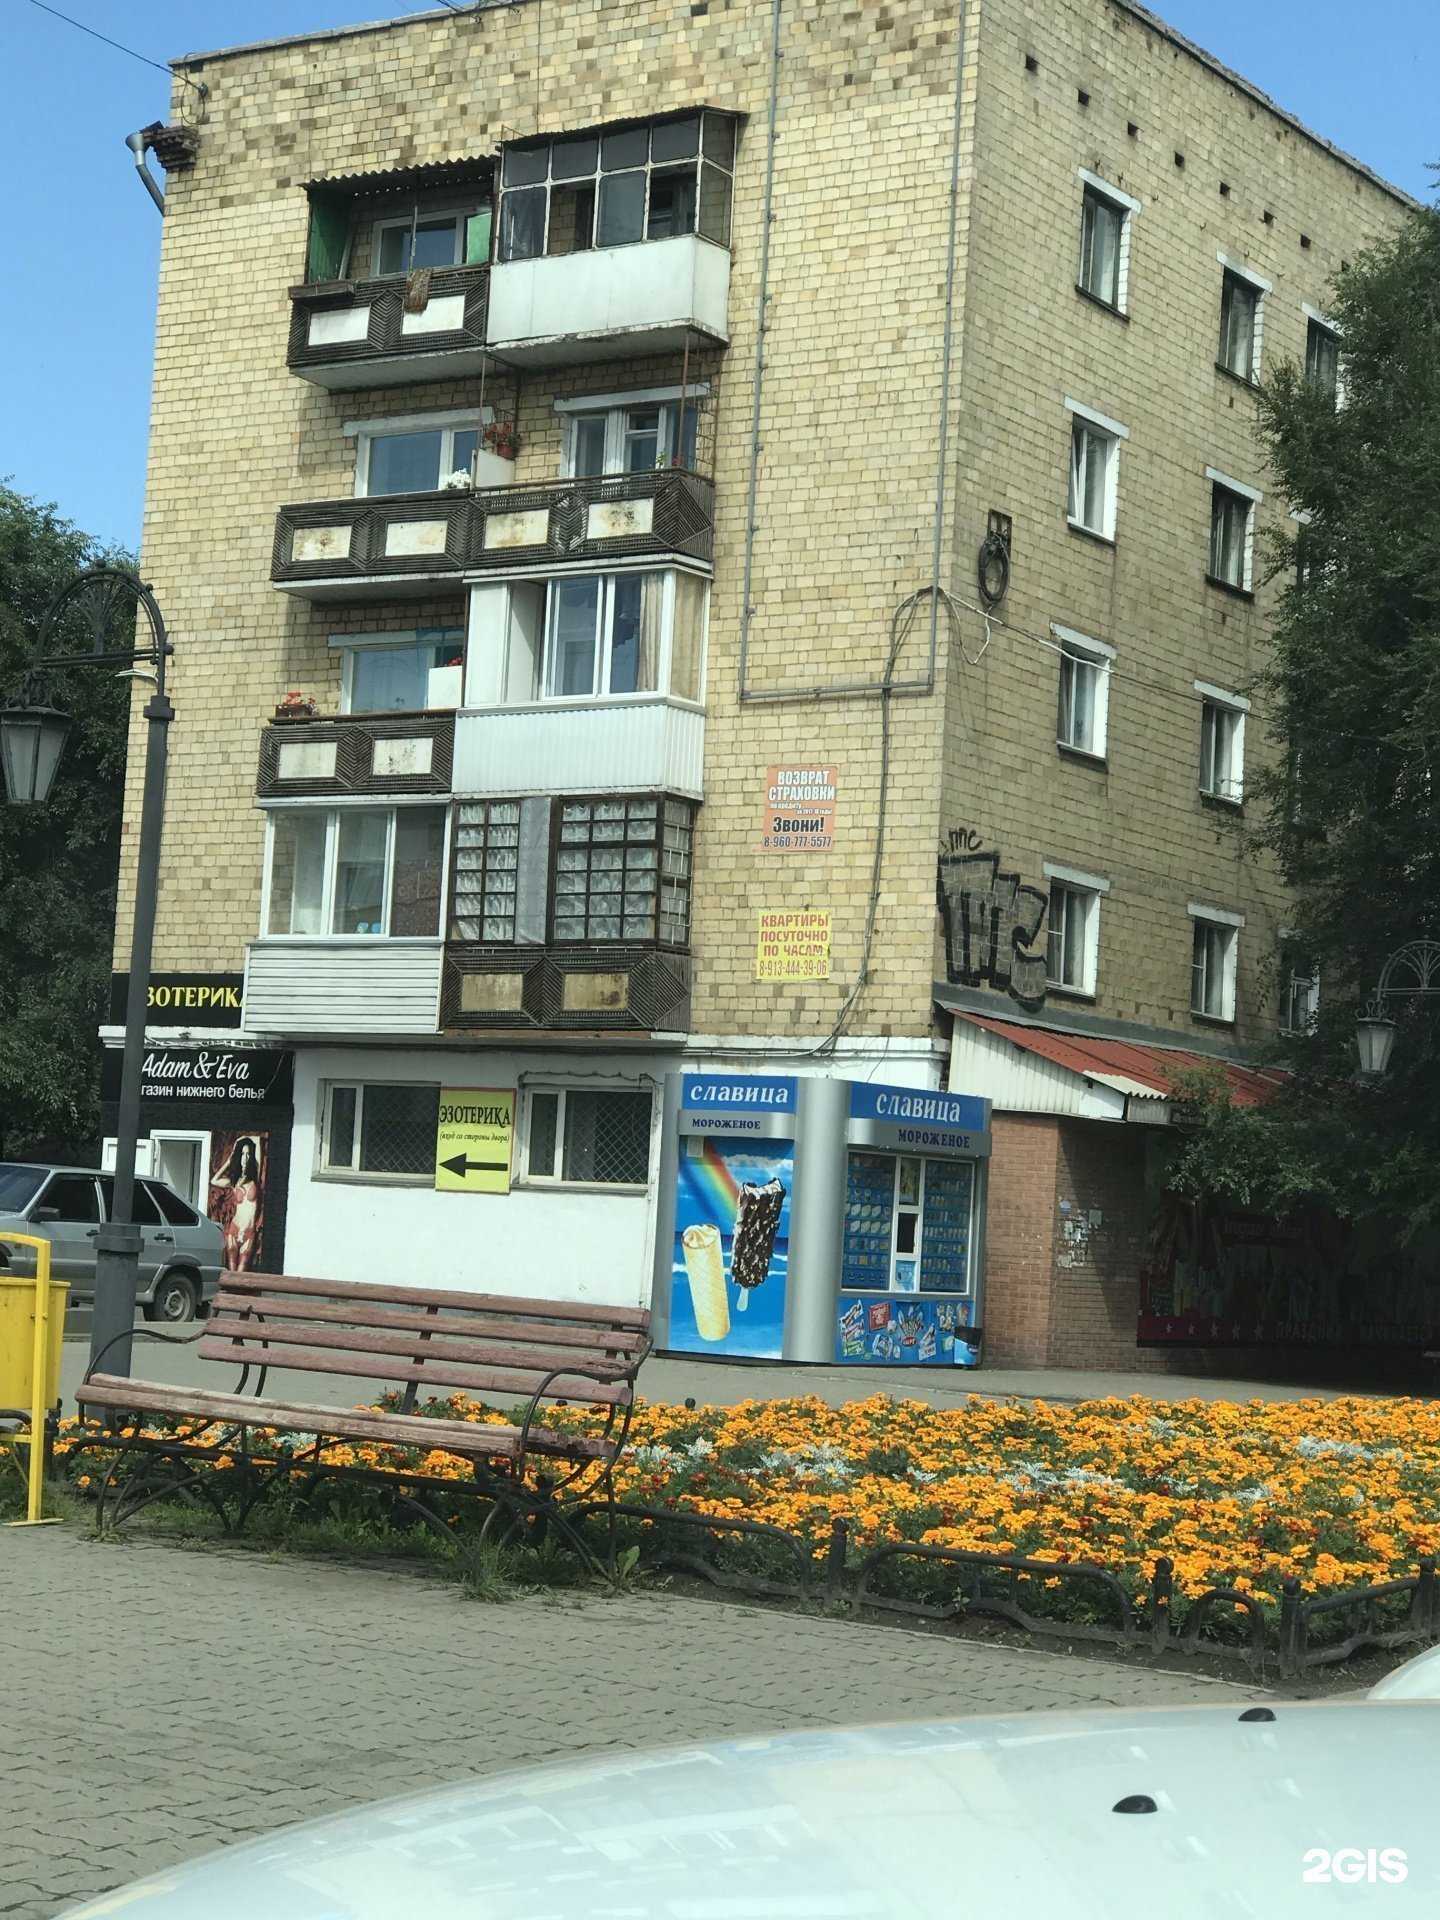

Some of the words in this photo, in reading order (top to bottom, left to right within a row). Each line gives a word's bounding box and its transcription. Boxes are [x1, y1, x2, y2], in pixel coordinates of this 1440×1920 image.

[777, 770, 829, 785] ВОЗВРАТ
[768, 785, 836, 801] СТРАХОВКИ
[773, 816, 825, 833] Звони!
[764, 836, 832, 847] 8-960-777-5577
[761, 914, 829, 927] КВАРТИРЫ
[760, 930, 828, 942] ПОСУТОЧНО
[763, 945, 779, 956] ПО
[783, 945, 823, 956] ЧАСАМ
[759, 960, 828, 976] 8-913-444-39-06
[146, 986, 243, 1009] ЗОТЕРИК
[141, 1085, 173, 1097] газин
[176, 1085, 225, 1098] нижнего
[228, 1084, 265, 1099] белья
[439, 1105, 511, 1128] ЭЗОТЕРИКА
[692, 1118, 761, 1130] МОРОЖЕНОЕ
[898, 1129, 970, 1149] МОРОЖЕНОЕ
